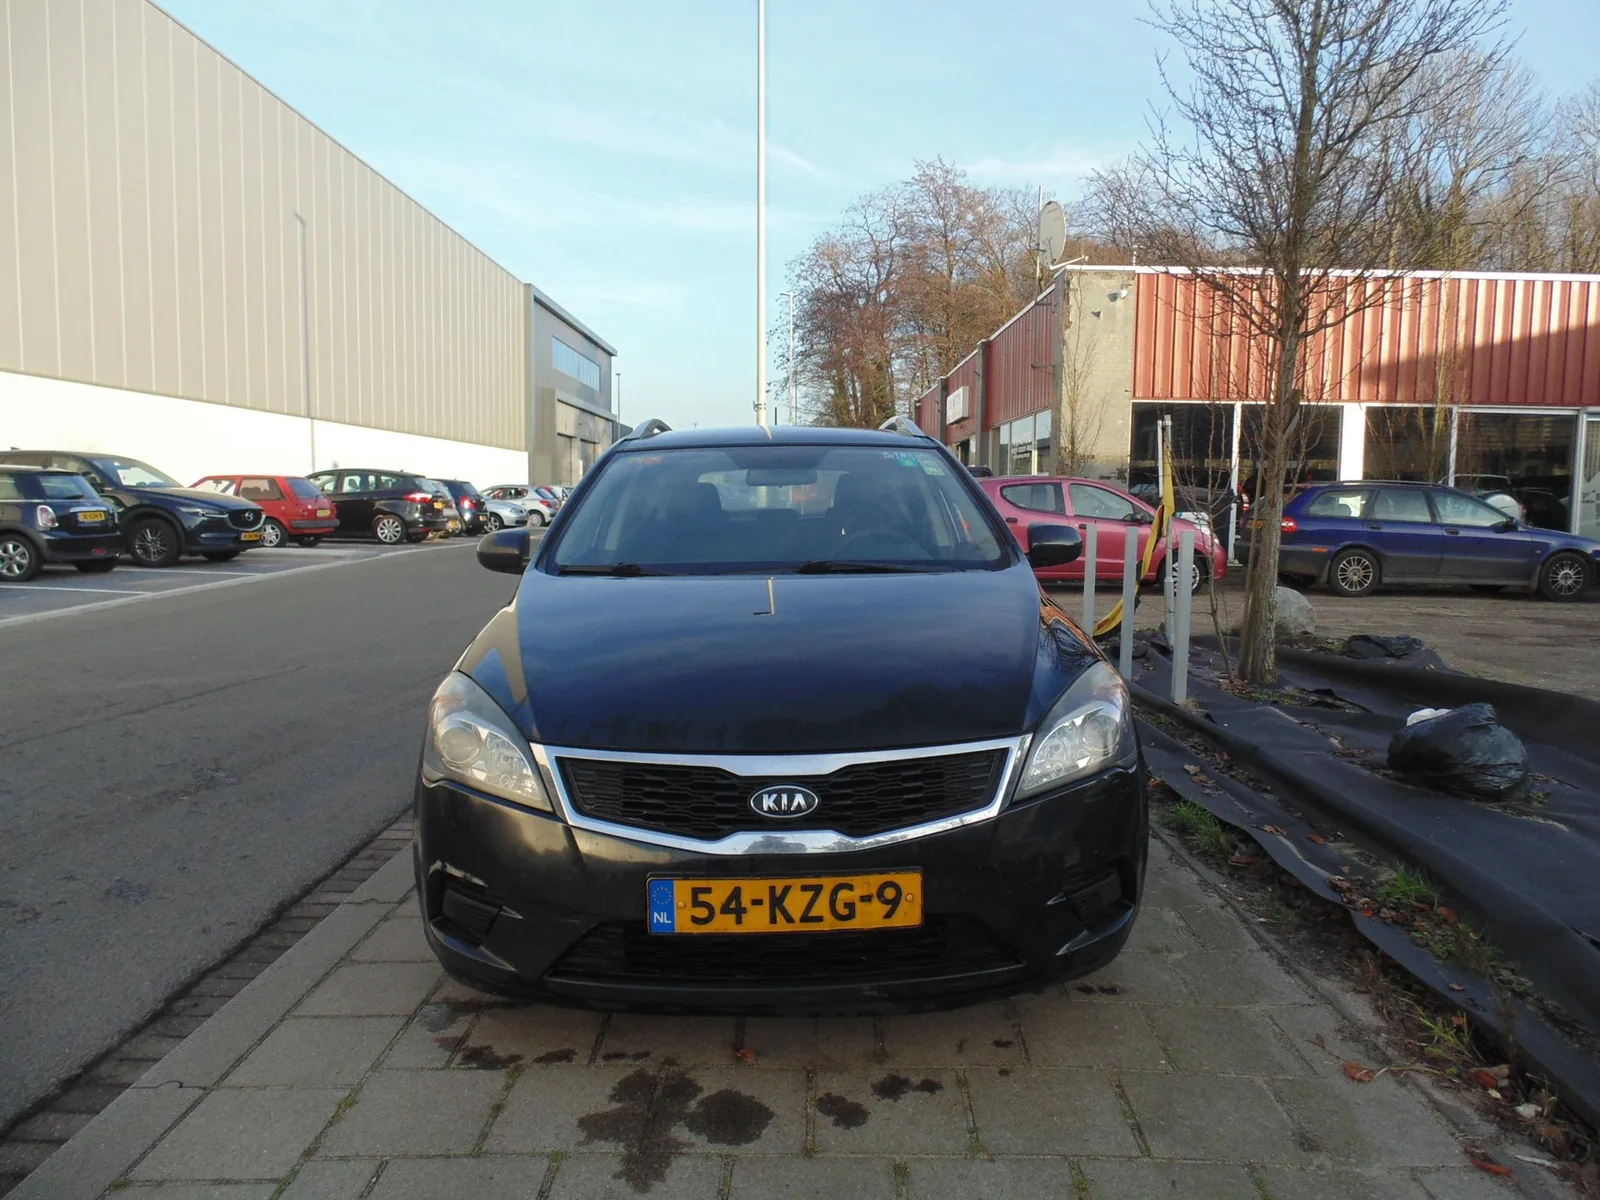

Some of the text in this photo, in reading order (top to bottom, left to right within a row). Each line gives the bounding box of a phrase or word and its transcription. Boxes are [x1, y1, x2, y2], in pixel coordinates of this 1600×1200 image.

[762, 793, 807, 811] KIA
[653, 880, 903, 926] NL 54-KZG-9
